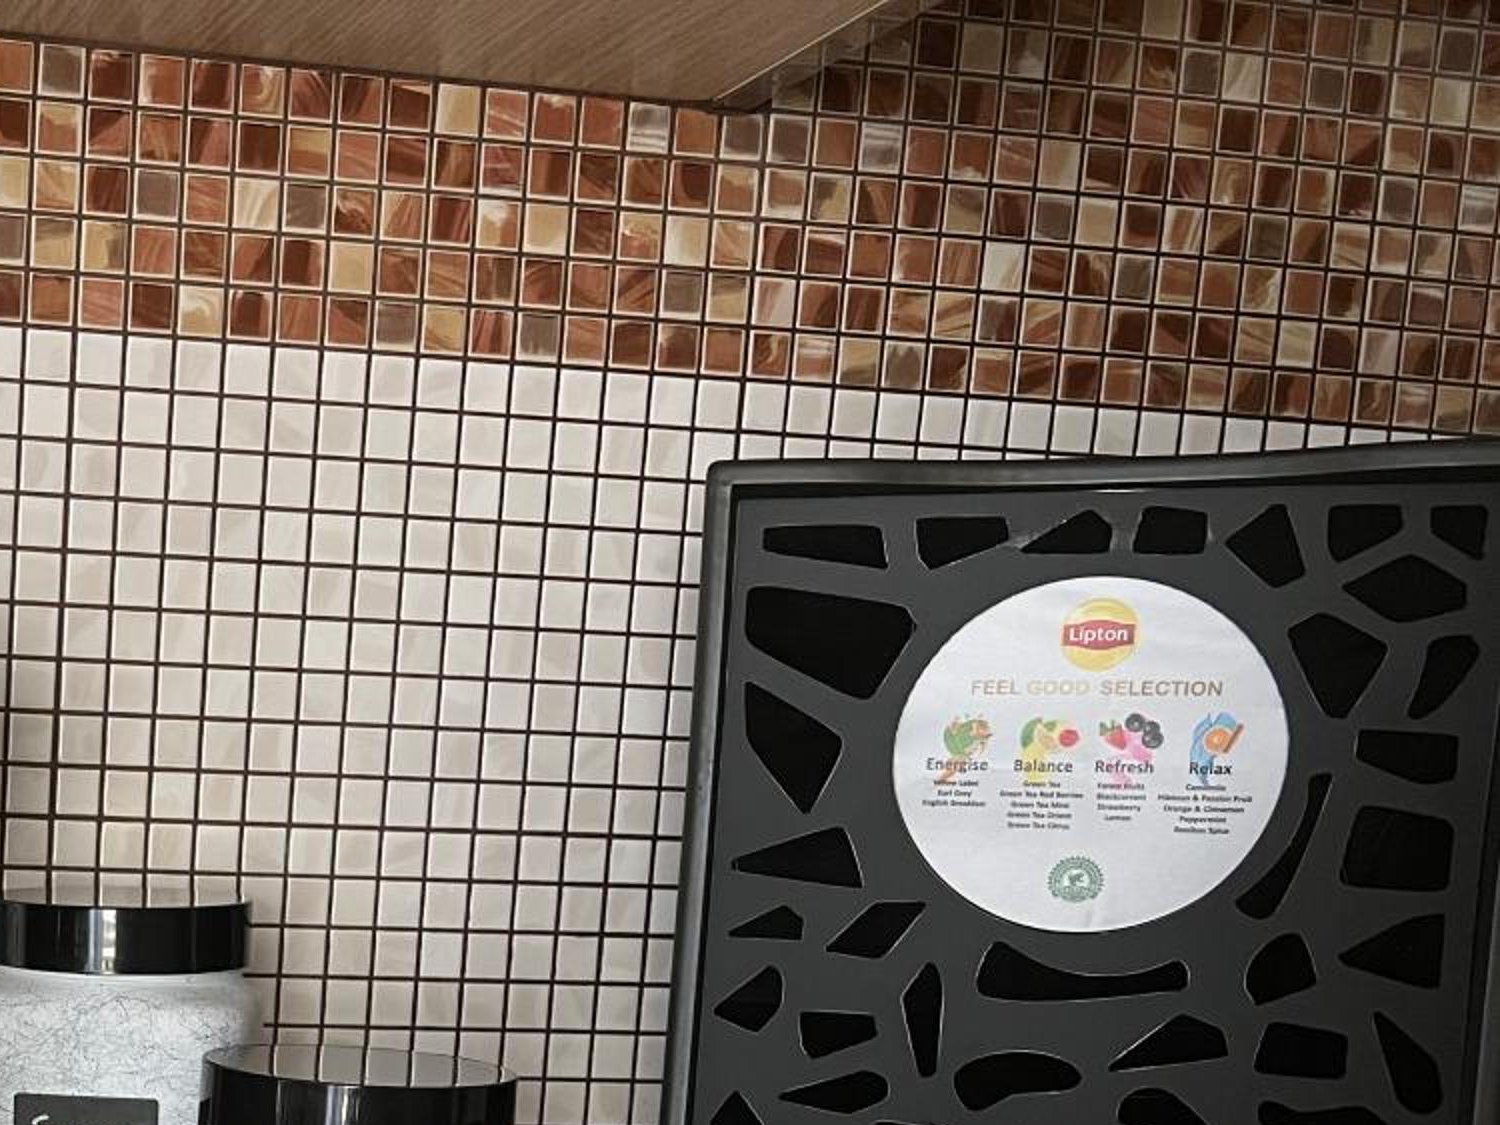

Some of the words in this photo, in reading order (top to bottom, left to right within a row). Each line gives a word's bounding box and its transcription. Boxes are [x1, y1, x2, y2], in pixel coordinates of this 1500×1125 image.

[1069, 627, 1128, 644] Lipton
[971, 679, 1020, 695] FEEL
[1027, 680, 1090, 695] GOOD
[1100, 680, 1222, 697] SELECTION
[926, 757, 989, 774] Energise
[1013, 759, 1073, 773] Balance
[1095, 760, 1154, 774] Refresh
[1189, 762, 1233, 775] Relax
